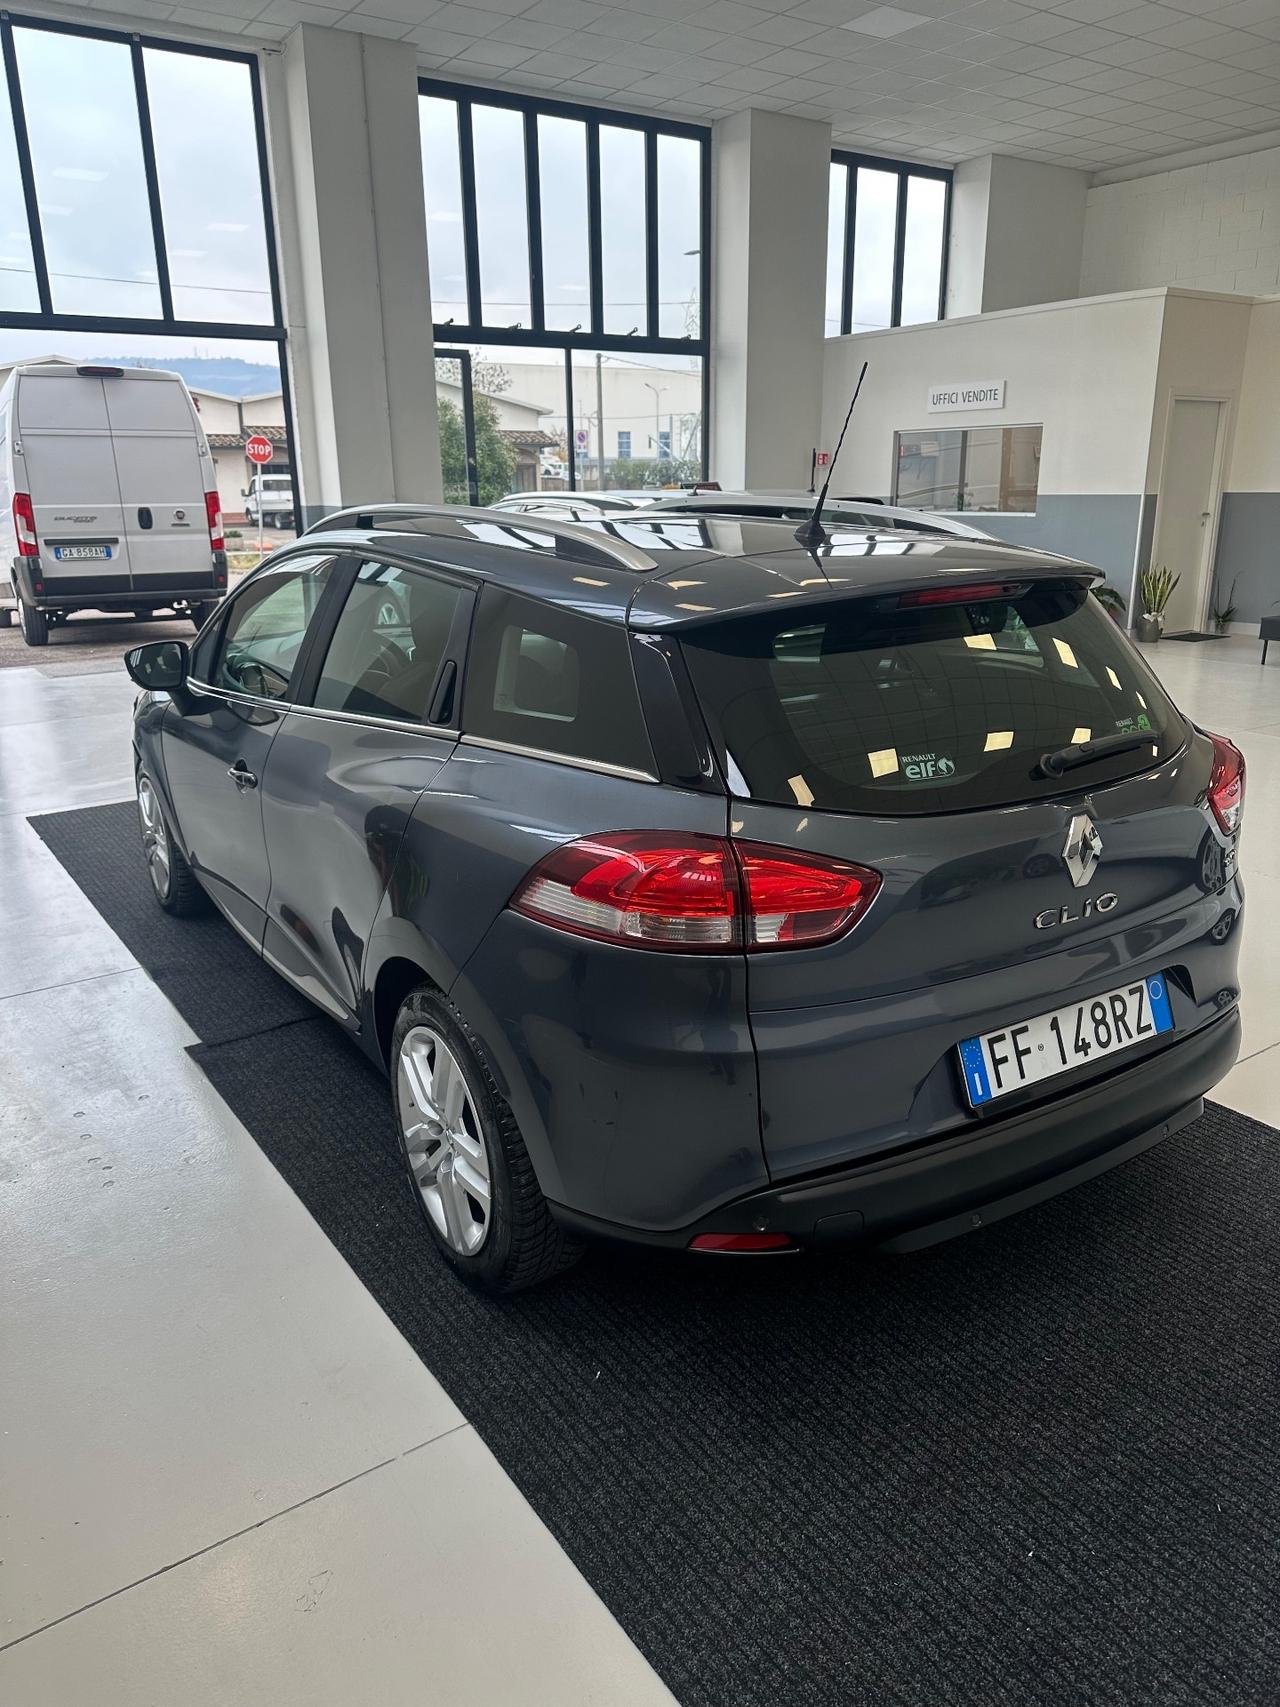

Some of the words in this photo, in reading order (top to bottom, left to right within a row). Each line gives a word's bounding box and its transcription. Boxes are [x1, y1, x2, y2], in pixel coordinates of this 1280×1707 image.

[932, 392, 959, 405] UFFICI
[961, 388, 999, 403] VENDITE
[248, 444, 271, 456] STOP
[901, 753, 936, 763] RENAULT
[905, 761, 936, 779] elf
